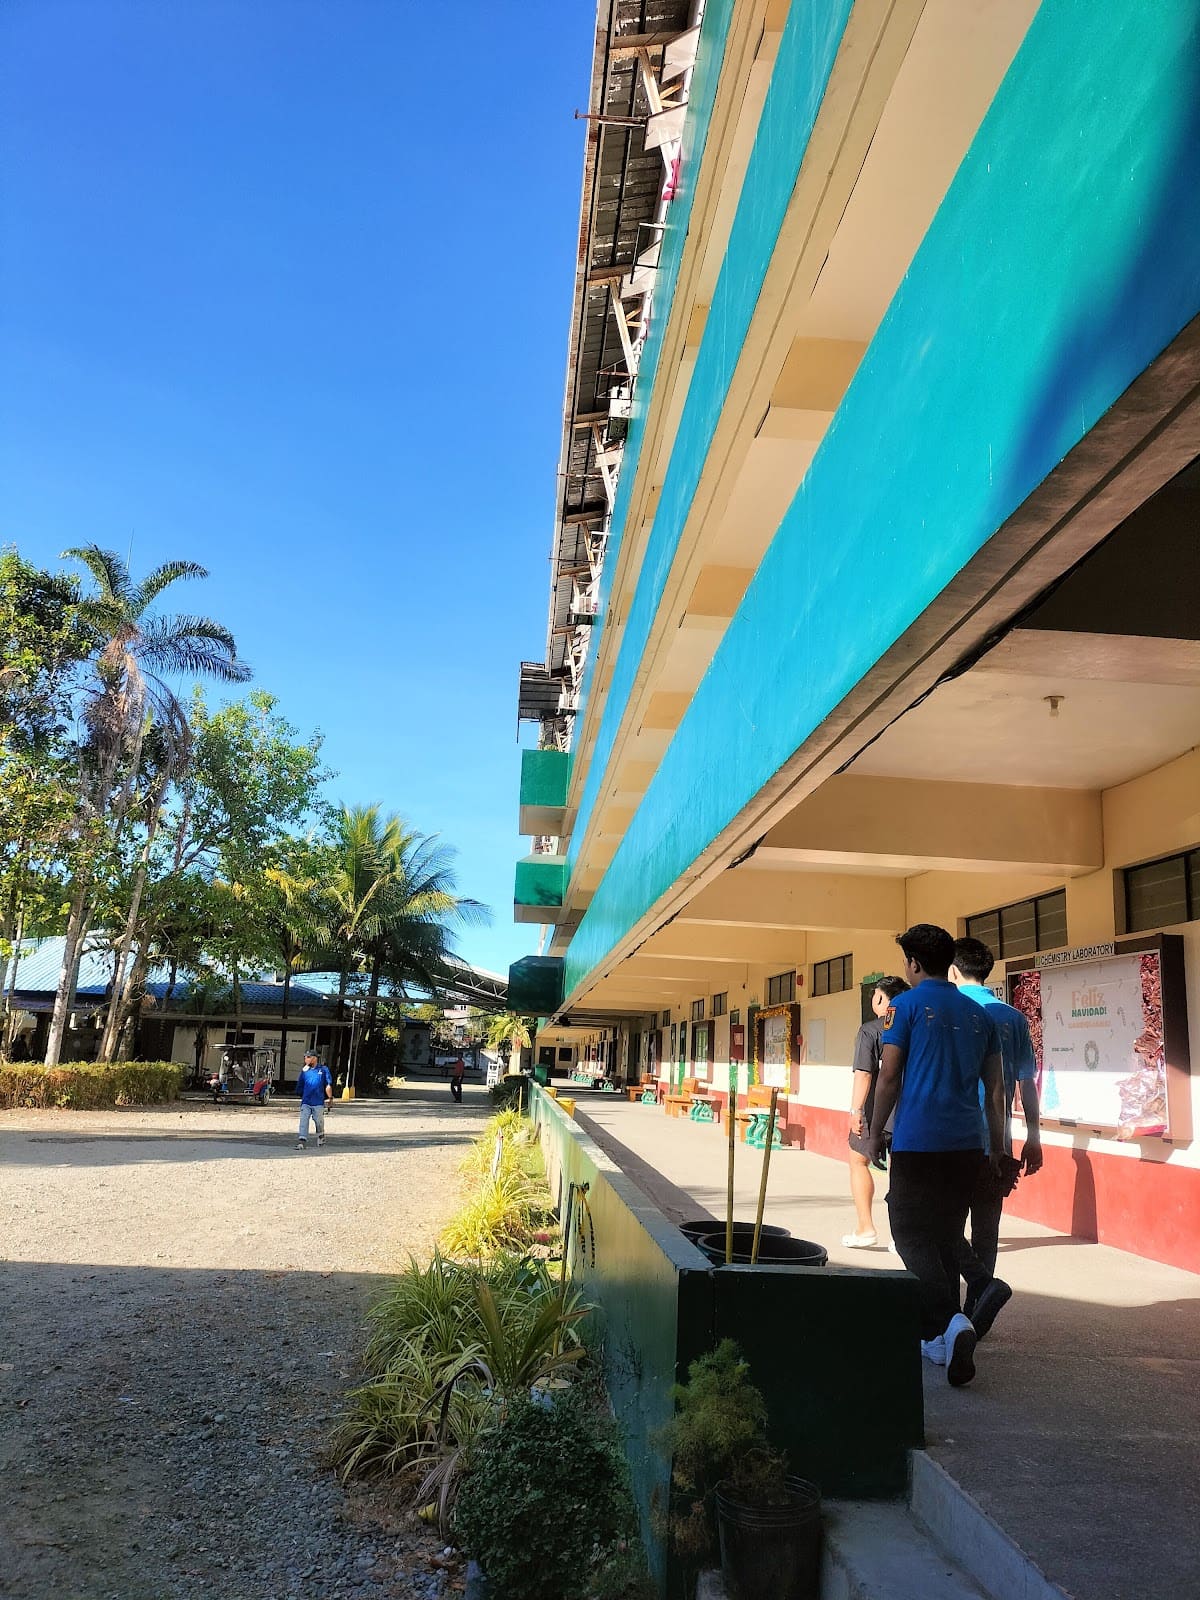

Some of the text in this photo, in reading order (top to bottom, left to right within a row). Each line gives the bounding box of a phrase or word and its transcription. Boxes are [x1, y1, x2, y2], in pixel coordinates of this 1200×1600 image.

[1041, 944, 1114, 965] CHEMISTRY LABORATORY
[1071, 988, 1105, 1008] Feliz
[1071, 1007, 1107, 1017] NAVIDAD!
